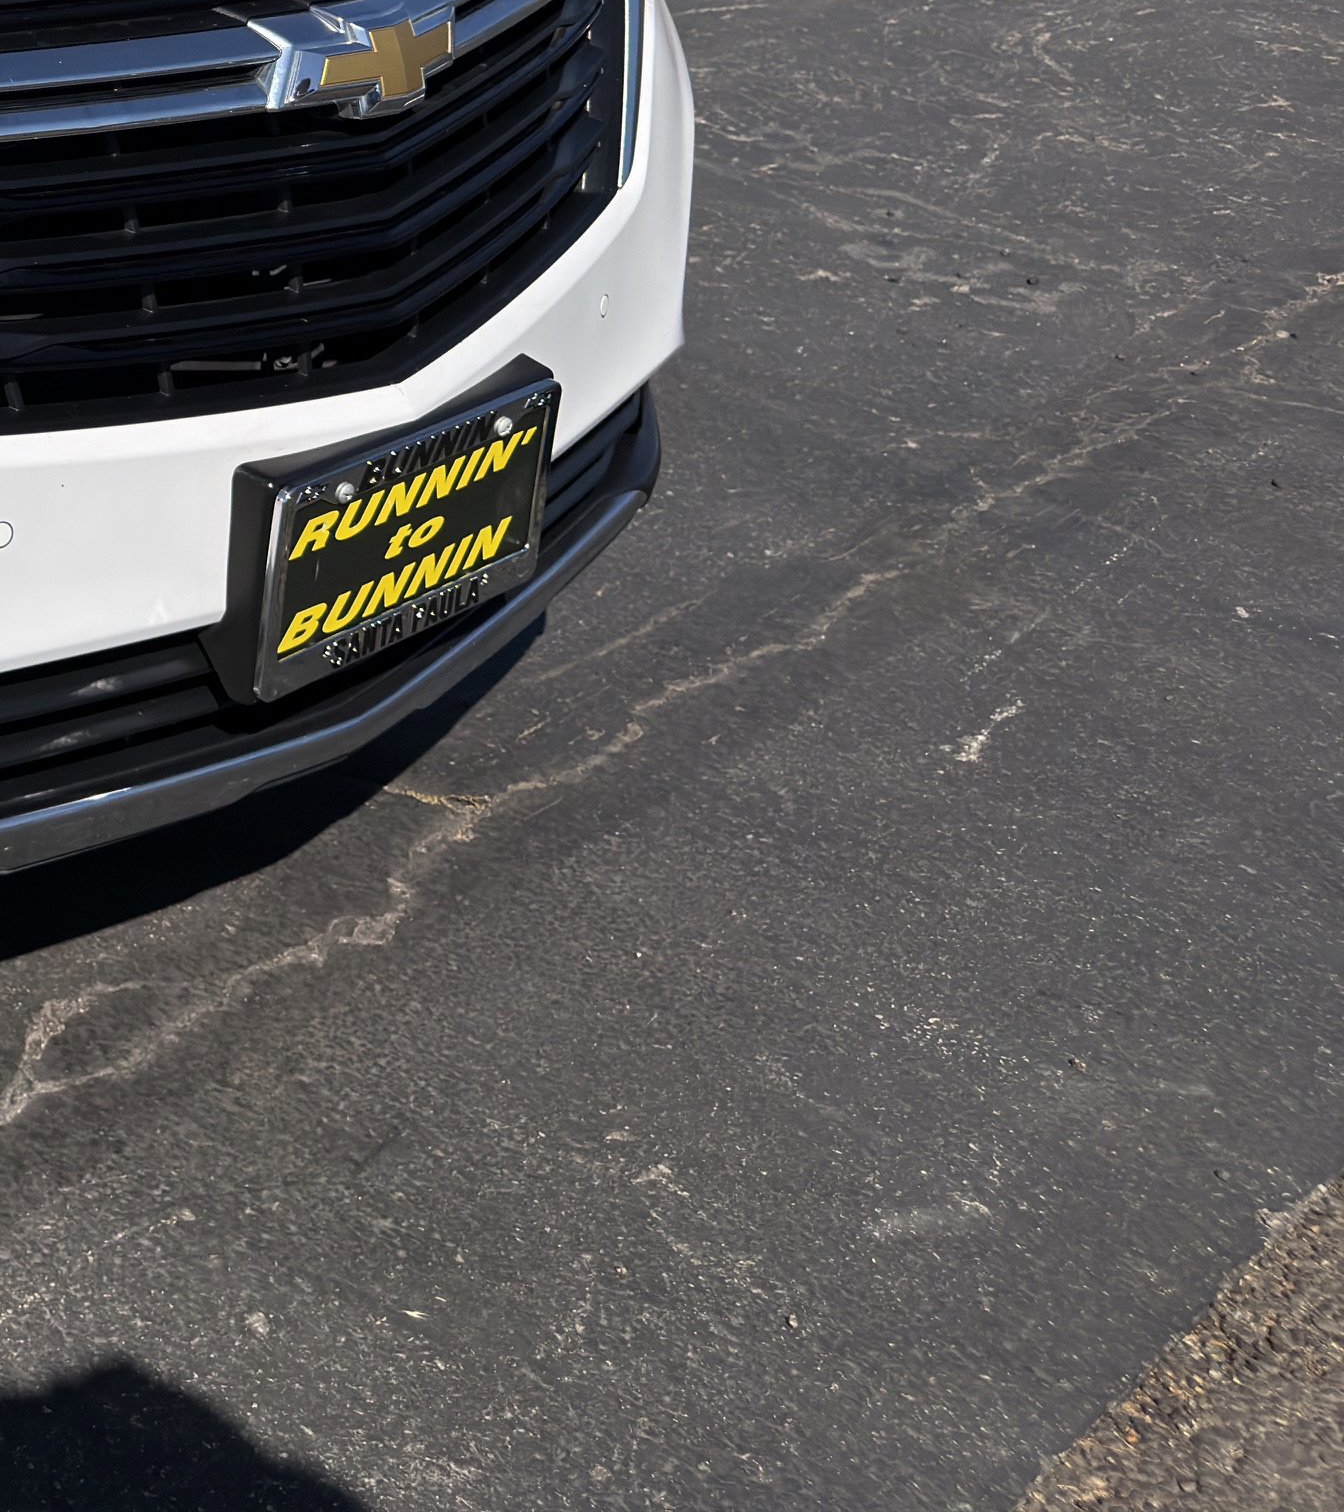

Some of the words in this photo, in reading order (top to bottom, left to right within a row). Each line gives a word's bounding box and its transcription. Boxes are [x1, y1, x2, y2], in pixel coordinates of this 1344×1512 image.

[288, 426, 538, 561] RUNNIN'
[384, 516, 445, 560] to
[277, 515, 513, 654] BUNNIN
